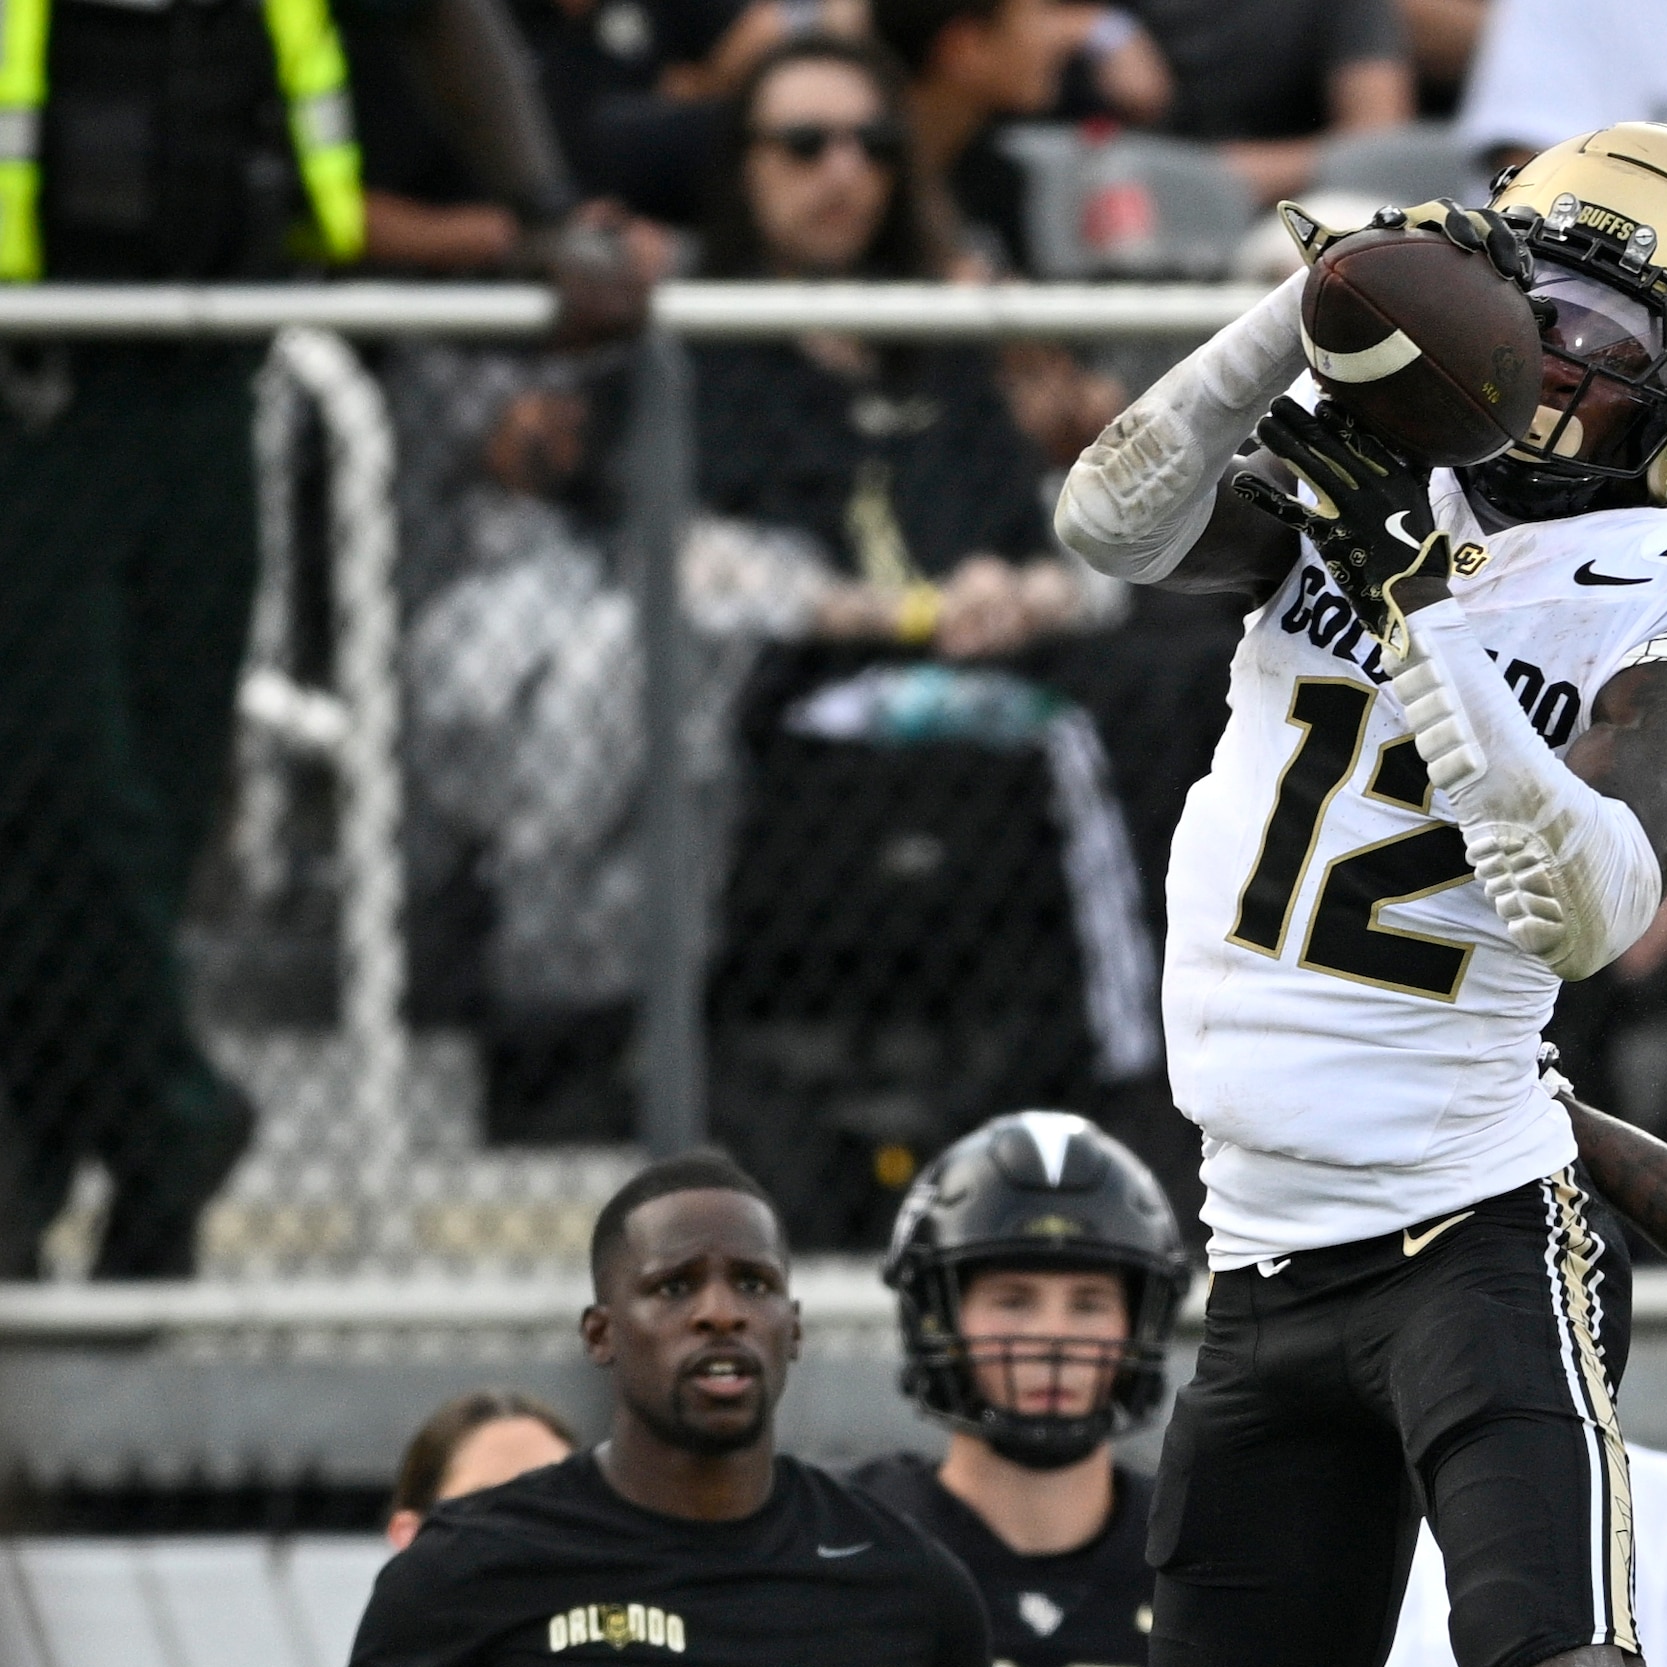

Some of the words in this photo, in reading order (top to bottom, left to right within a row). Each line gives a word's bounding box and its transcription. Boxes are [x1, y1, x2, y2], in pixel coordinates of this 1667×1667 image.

[1577, 206, 1635, 241] BUFFS
[1225, 676, 1476, 1004] 12
[550, 1603, 686, 1653] ORLNDO
